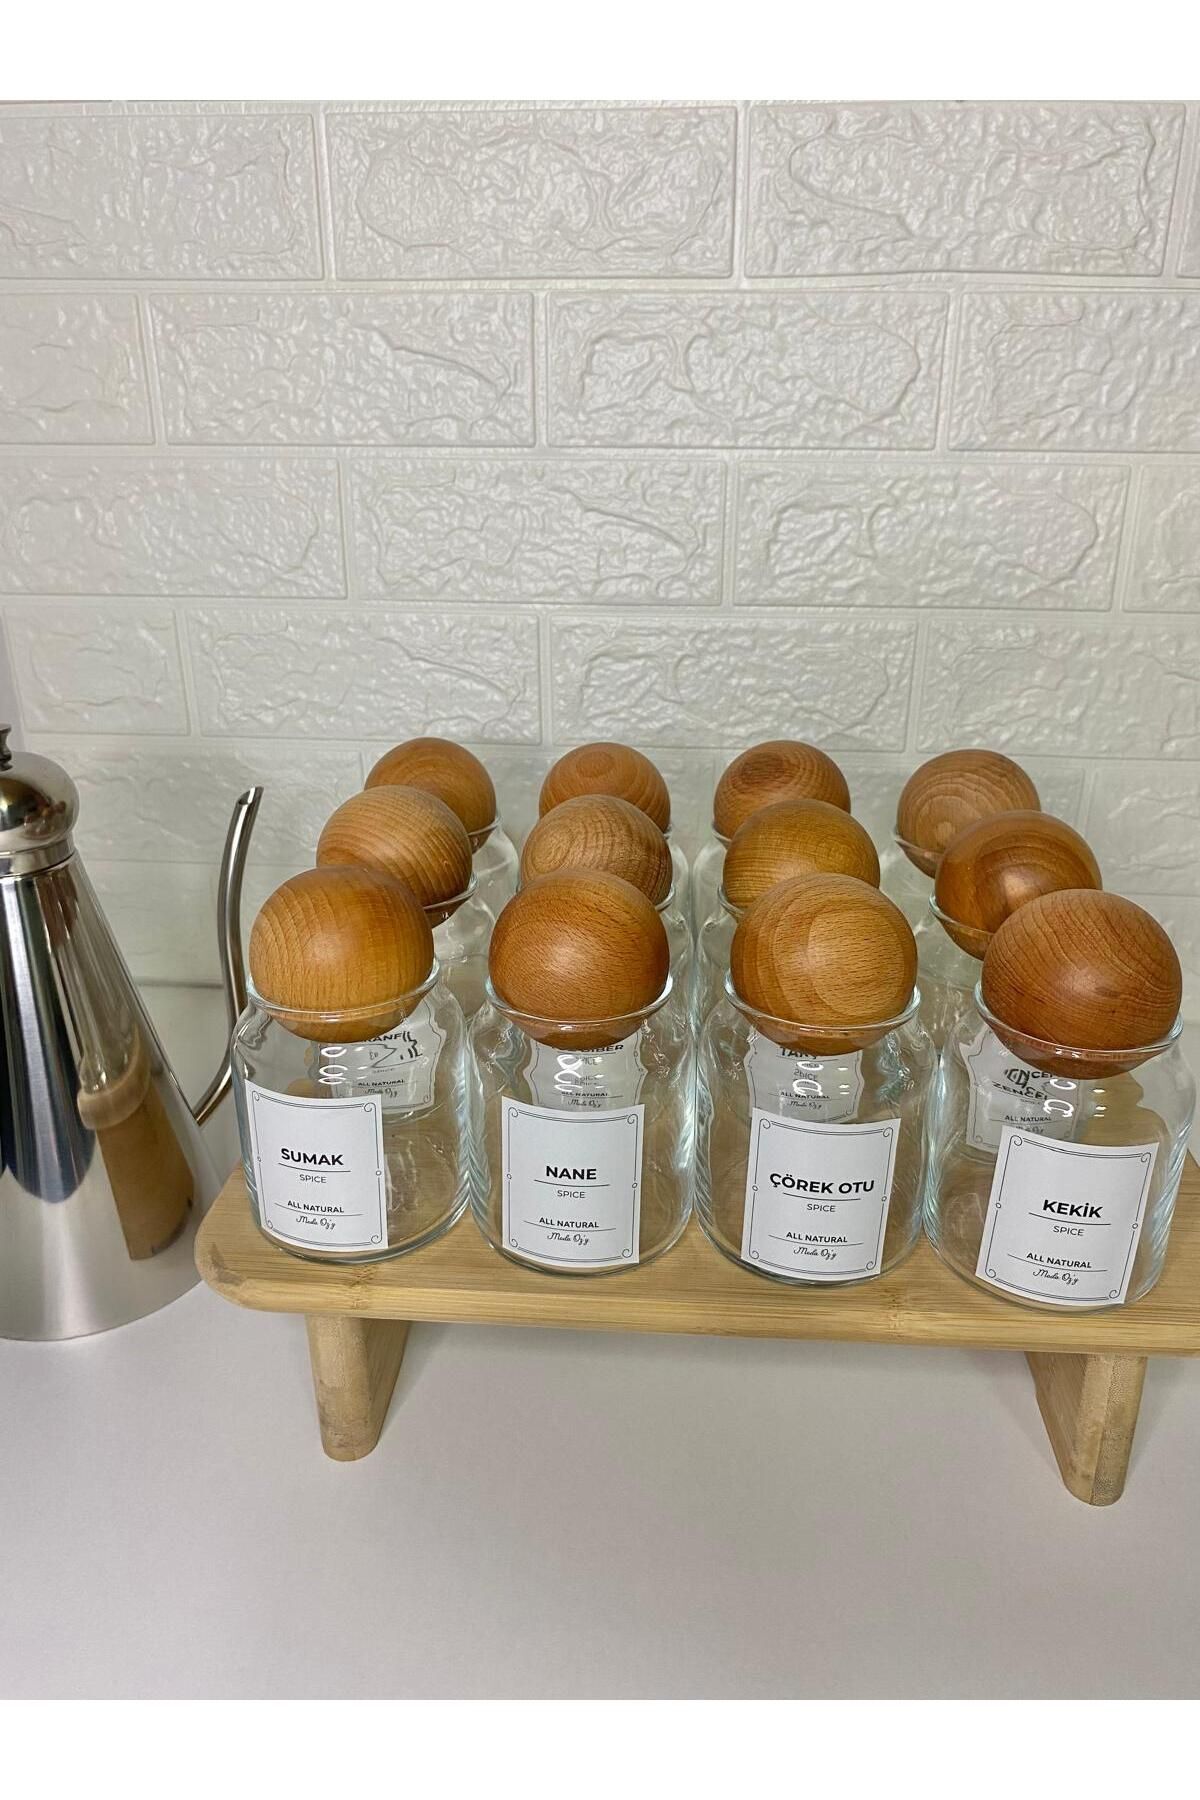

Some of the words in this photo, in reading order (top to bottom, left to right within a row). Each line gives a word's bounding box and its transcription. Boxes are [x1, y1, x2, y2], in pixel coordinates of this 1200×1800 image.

[281, 1148, 344, 1166] SUMAK
[299, 1173, 327, 1183] SPICE
[546, 1165, 597, 1180] NANE
[769, 1173, 834, 1194] ÇÖREK
[838, 1180, 875, 1194] OTU
[557, 1189, 586, 1199] SPICE
[287, 1200, 302, 1210] ALL
[303, 1203, 344, 1213] NATURAL
[806, 1203, 836, 1212] SPICE
[1042, 1199, 1103, 1218] KEKİK
[539, 1217, 555, 1226] ALL
[556, 1220, 600, 1229] NATURAL
[1053, 1225, 1085, 1236] SPICE
[786, 1231, 803, 1241] ALL
[805, 1234, 848, 1243] NATURAL
[1026, 1252, 1044, 1262] ALL
[1046, 1257, 1092, 1268] NATURAL
